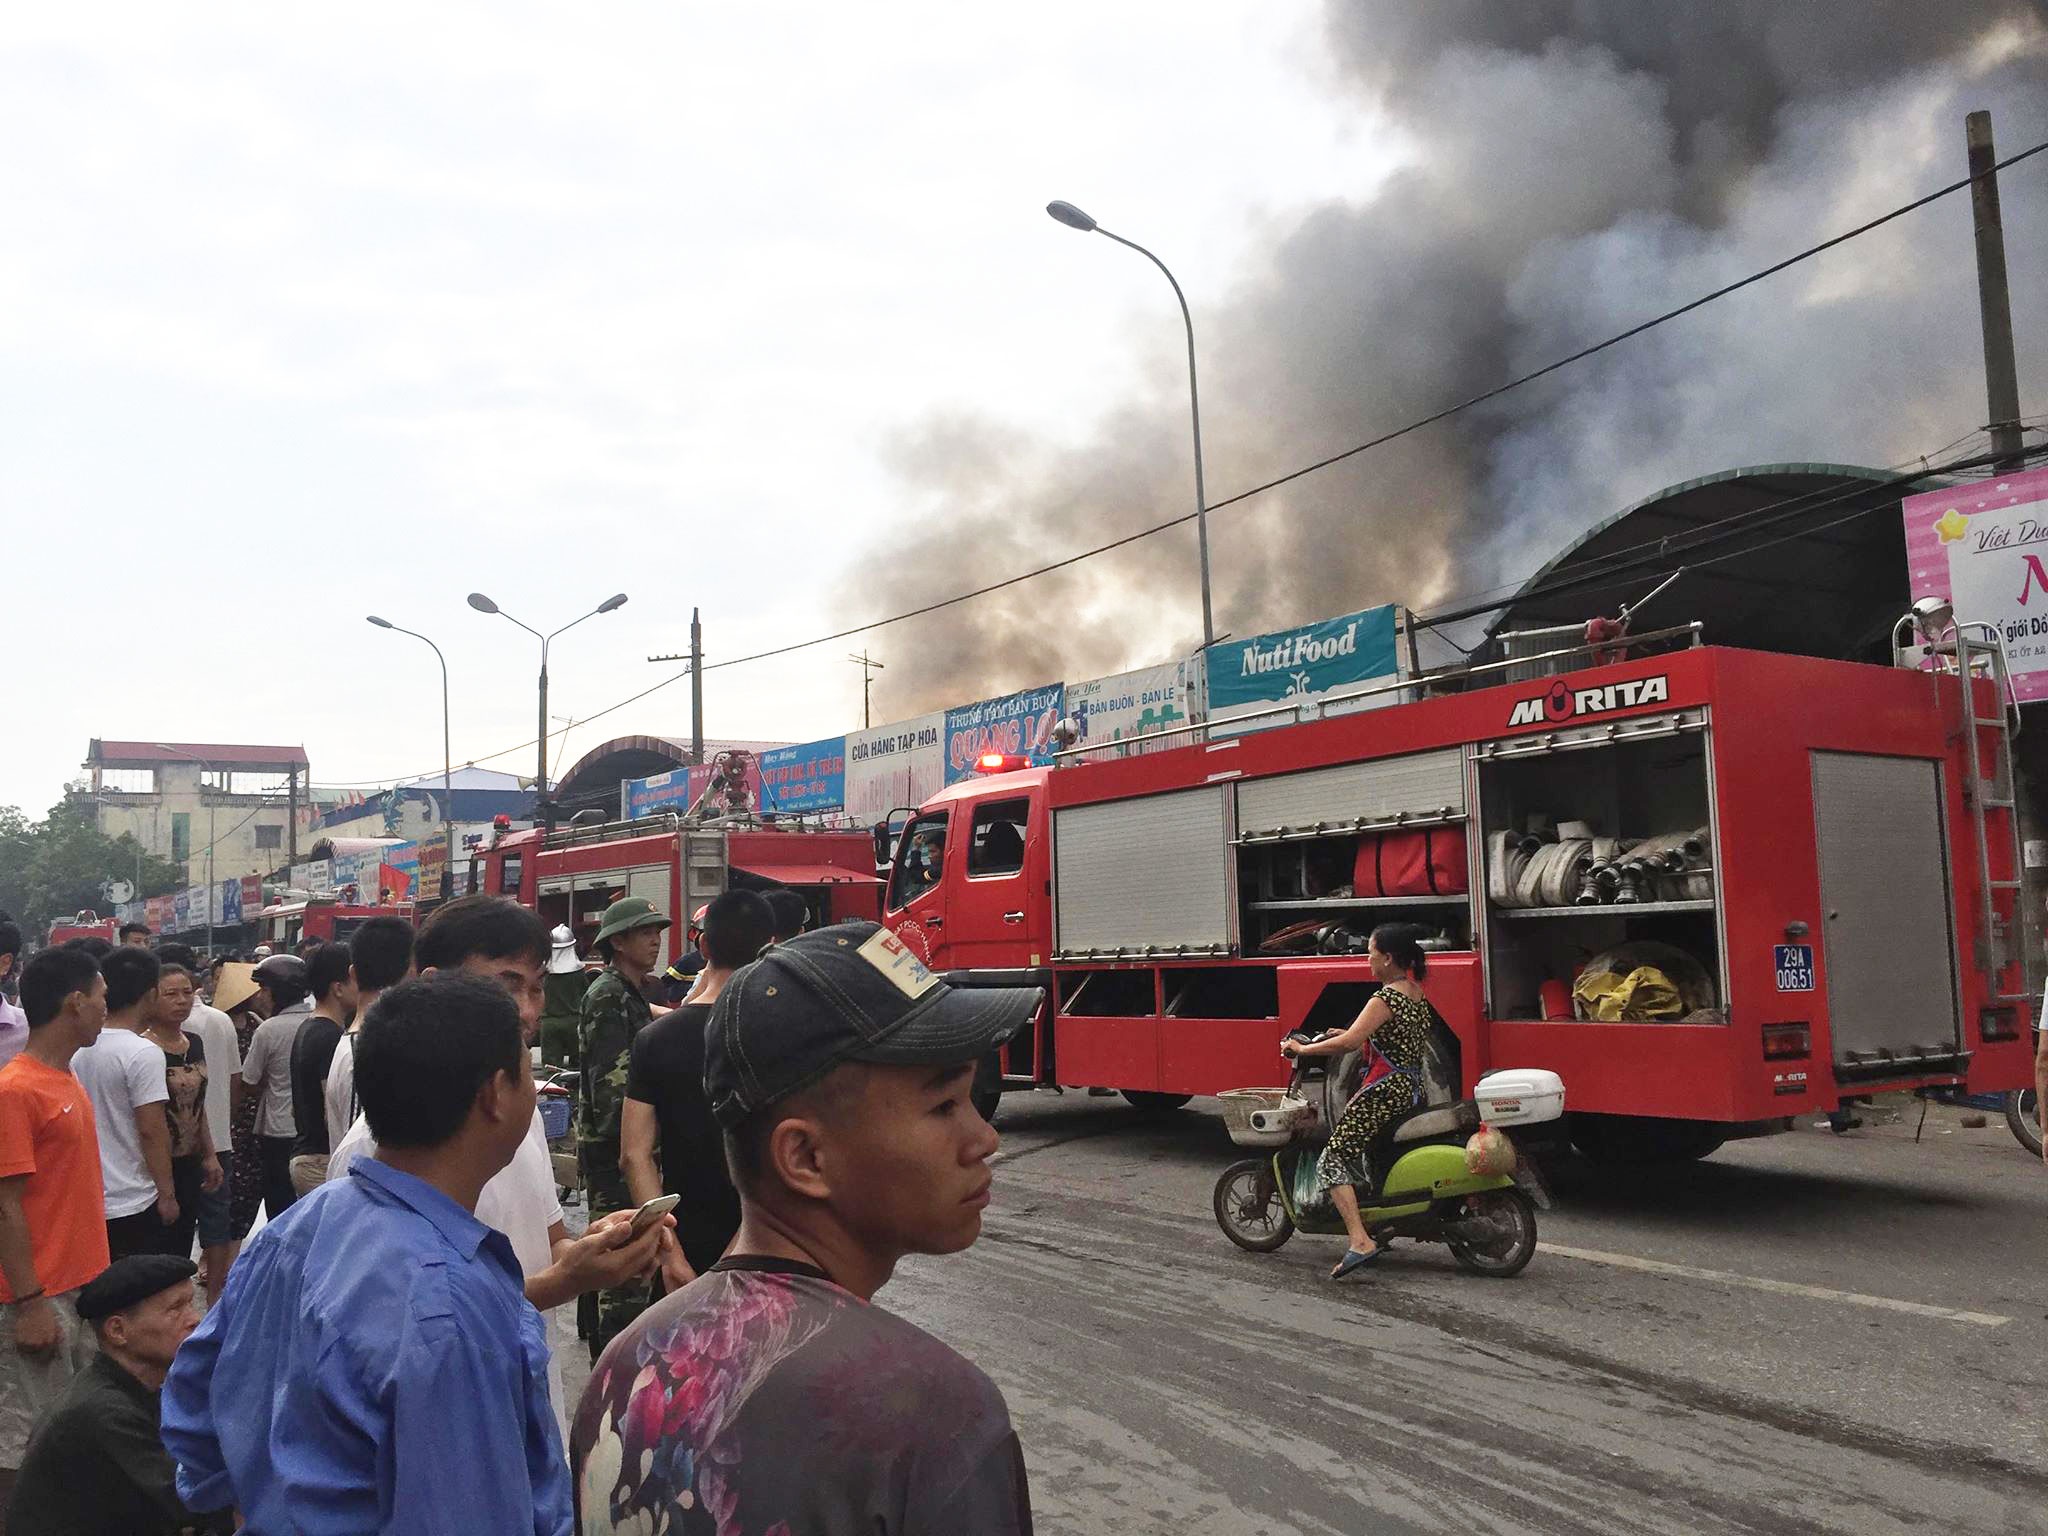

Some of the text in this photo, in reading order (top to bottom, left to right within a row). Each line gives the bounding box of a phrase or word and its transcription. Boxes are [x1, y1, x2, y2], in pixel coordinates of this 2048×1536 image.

[1241, 622, 1358, 677] NutiFood
[1507, 674, 1668, 727] MORITA
[852, 724, 938, 761] CỬA HÀNG TẠP HÓA
[1783, 947, 1805, 968] 29A
[1776, 968, 1813, 989] 006.51
[1773, 1072, 1807, 1083] MRITA
